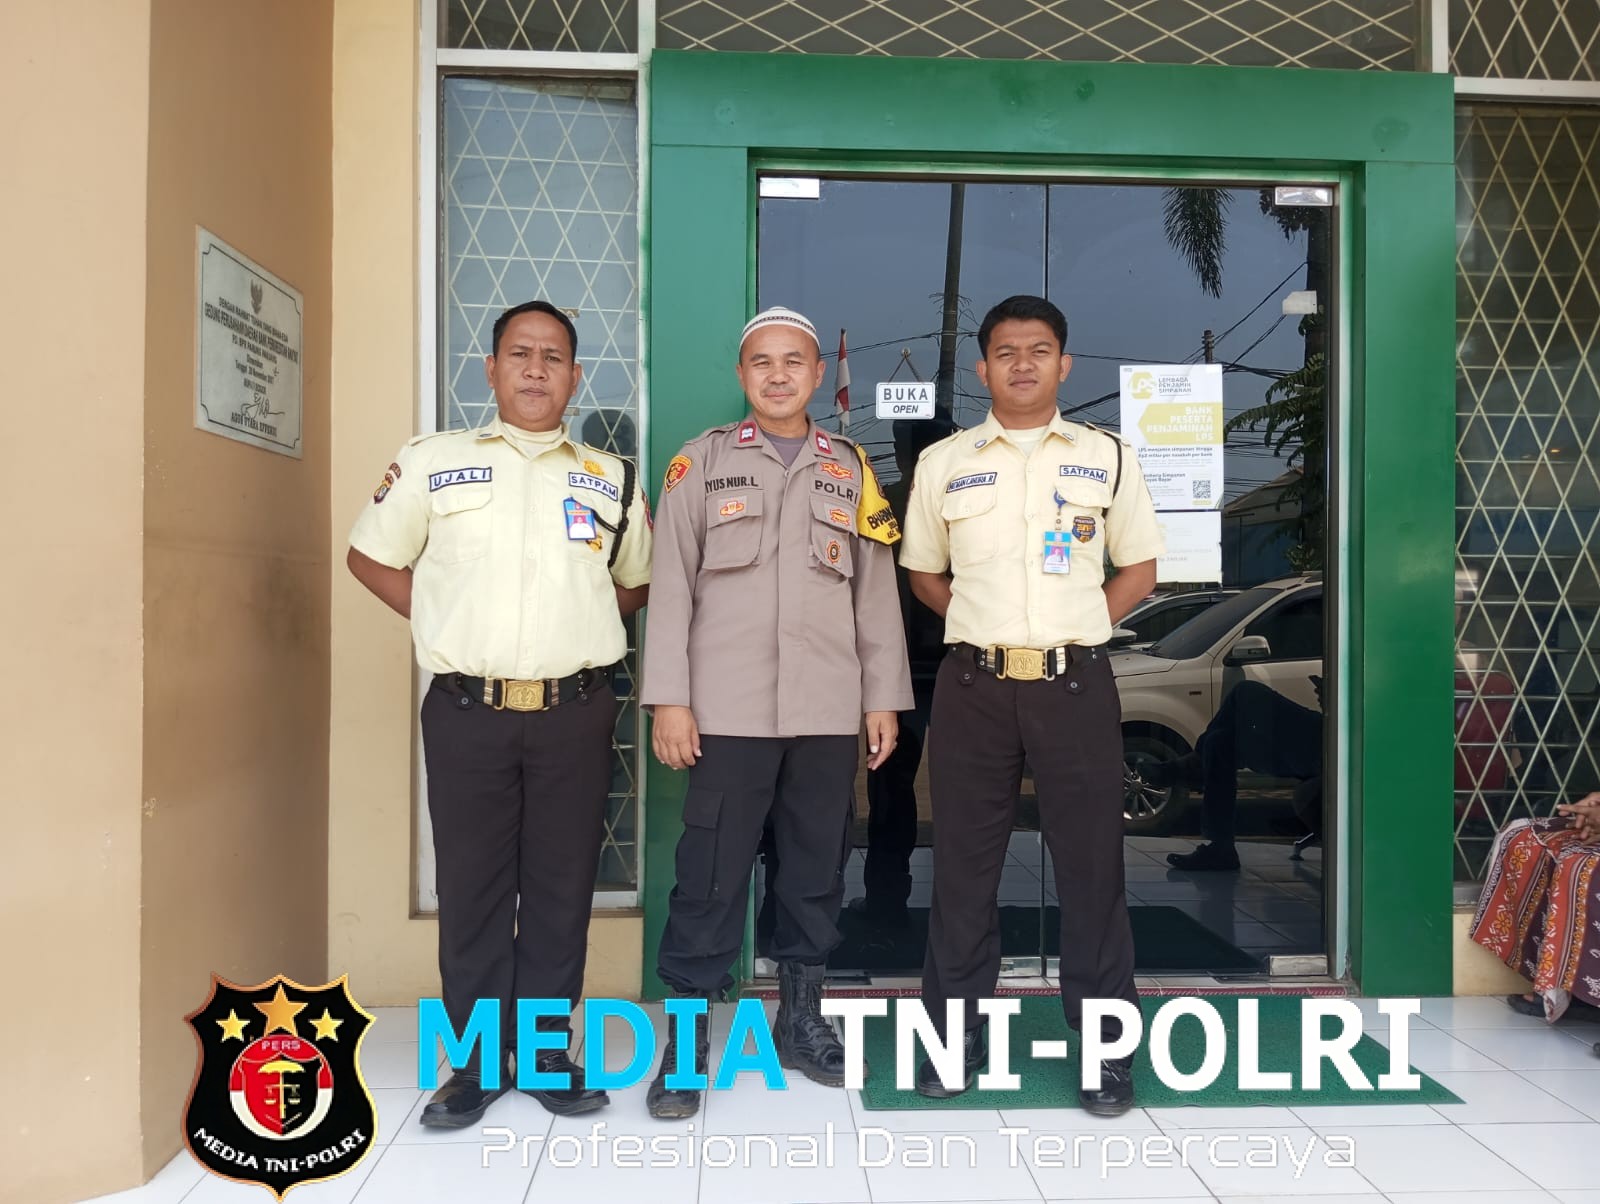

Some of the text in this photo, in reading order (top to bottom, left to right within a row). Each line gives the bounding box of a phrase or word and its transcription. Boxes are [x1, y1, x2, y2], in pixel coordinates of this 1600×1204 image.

[884, 388, 928, 400] BUKA
[892, 405, 919, 414] OPEN
[1185, 406, 1212, 414] BANK
[1170, 416, 1213, 424] PESERTA
[432, 470, 488, 487] UJALI
[1063, 467, 1105, 480] SATPAM
[571, 476, 616, 497] SATPAM
[814, 480, 858, 504] POLRI
